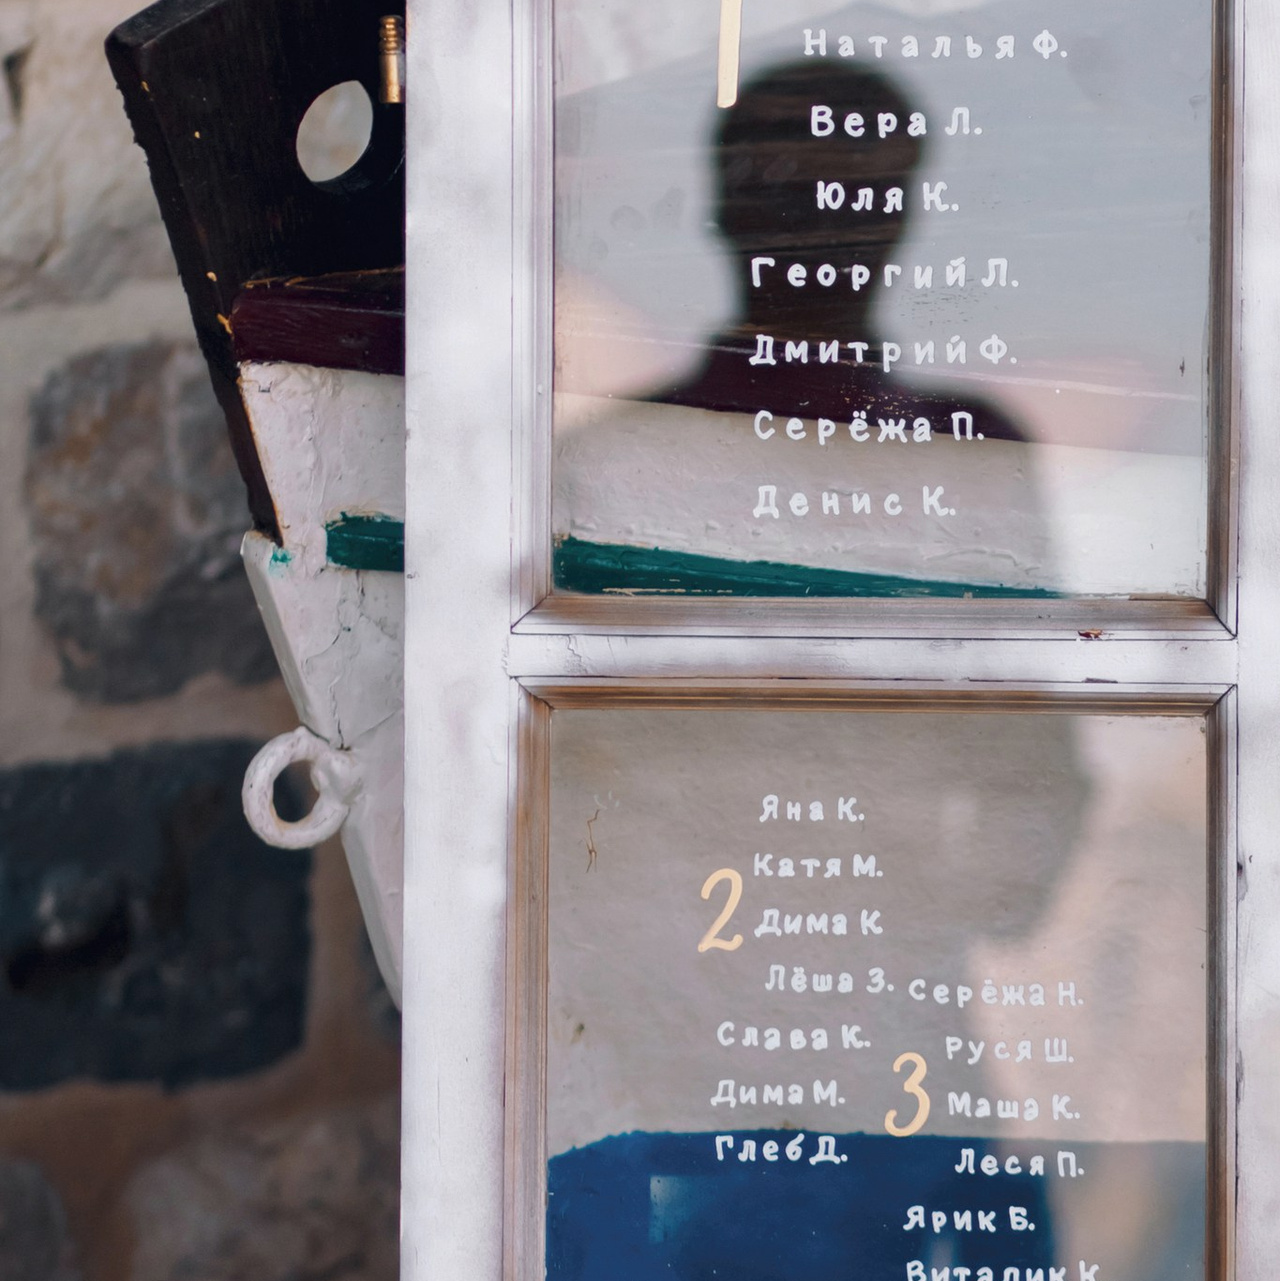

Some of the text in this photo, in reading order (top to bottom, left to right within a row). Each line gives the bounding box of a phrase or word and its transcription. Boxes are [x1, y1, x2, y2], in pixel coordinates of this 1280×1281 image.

[803, 29, 1068, 59] Наталья Ф.
[810, 106, 983, 138] Вера Л.
[816, 182, 959, 212] Юля К.
[751, 257, 1019, 290] Георгий Л.
[749, 335, 1017, 372] Дмитрий Ф.
[754, 409, 984, 445] Серёжа П.
[753, 485, 956, 518] Денис К.
[759, 795, 864, 822] Яна К.
[753, 853, 884, 878] Катя М.
[698, 868, 743, 952] 2
[754, 909, 847, 938] Дима
[765, 964, 894, 993] Лёша З.
[908, 978, 1084, 1007] Серёжа Н.
[717, 1022, 870, 1050] Слава К.
[945, 1036, 1074, 1064] Руся Ш.
[711, 1080, 845, 1107] Дима М.
[885, 1052, 930, 1137] 3
[948, 1092, 1080, 1120] Маша К.
[716, 1132, 847, 1164] Глеб Д.
[955, 1149, 1084, 1177] Леся П.
[903, 1206, 1035, 1234] Ярик Б.
